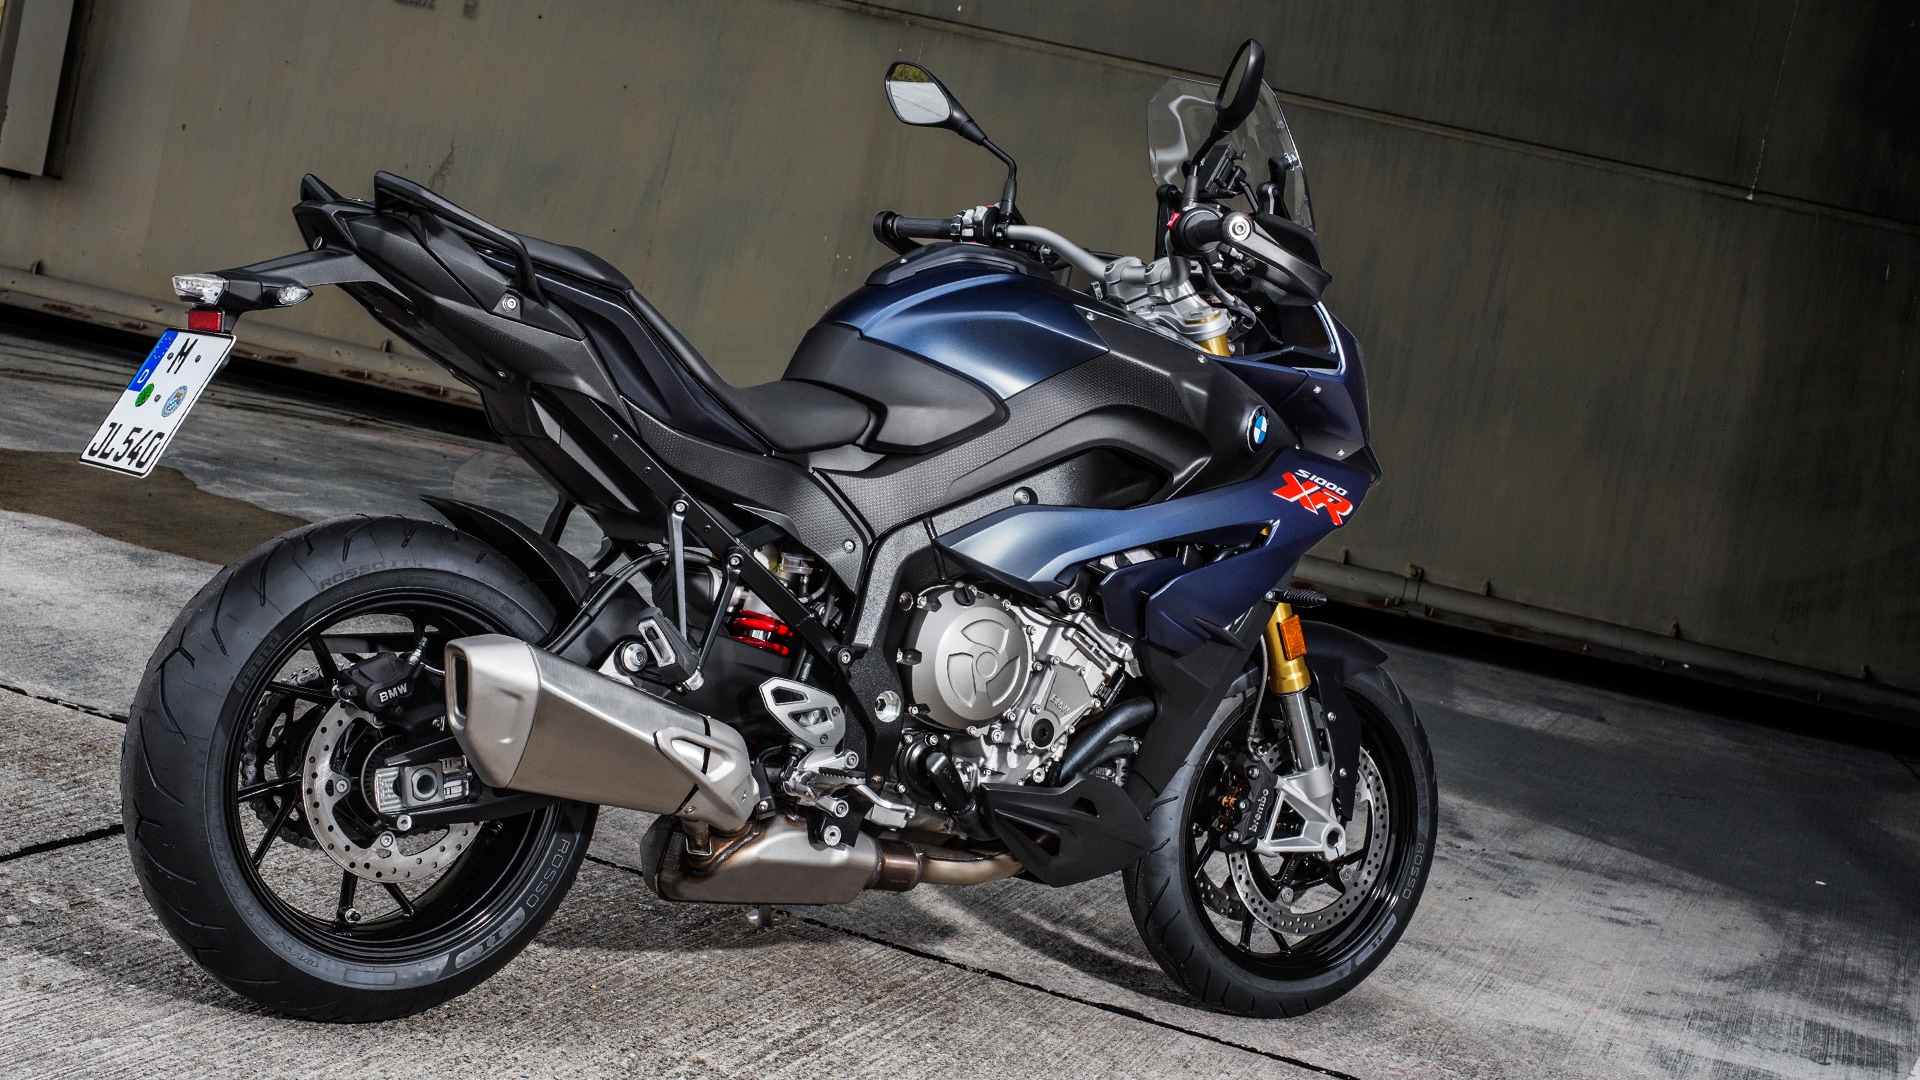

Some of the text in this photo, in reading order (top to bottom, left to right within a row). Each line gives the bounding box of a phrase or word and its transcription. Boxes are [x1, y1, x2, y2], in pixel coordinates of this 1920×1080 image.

[167, 338, 198, 374] M
[137, 369, 150, 384] D
[1271, 471, 1354, 526] XR
[1294, 468, 1348, 496] S1000
[319, 561, 383, 590] ROSSO
[379, 682, 408, 703] BMW
[1248, 788, 1269, 833] brembo
[525, 838, 571, 909] ROSSO
[1402, 842, 1425, 900] ROSSO
